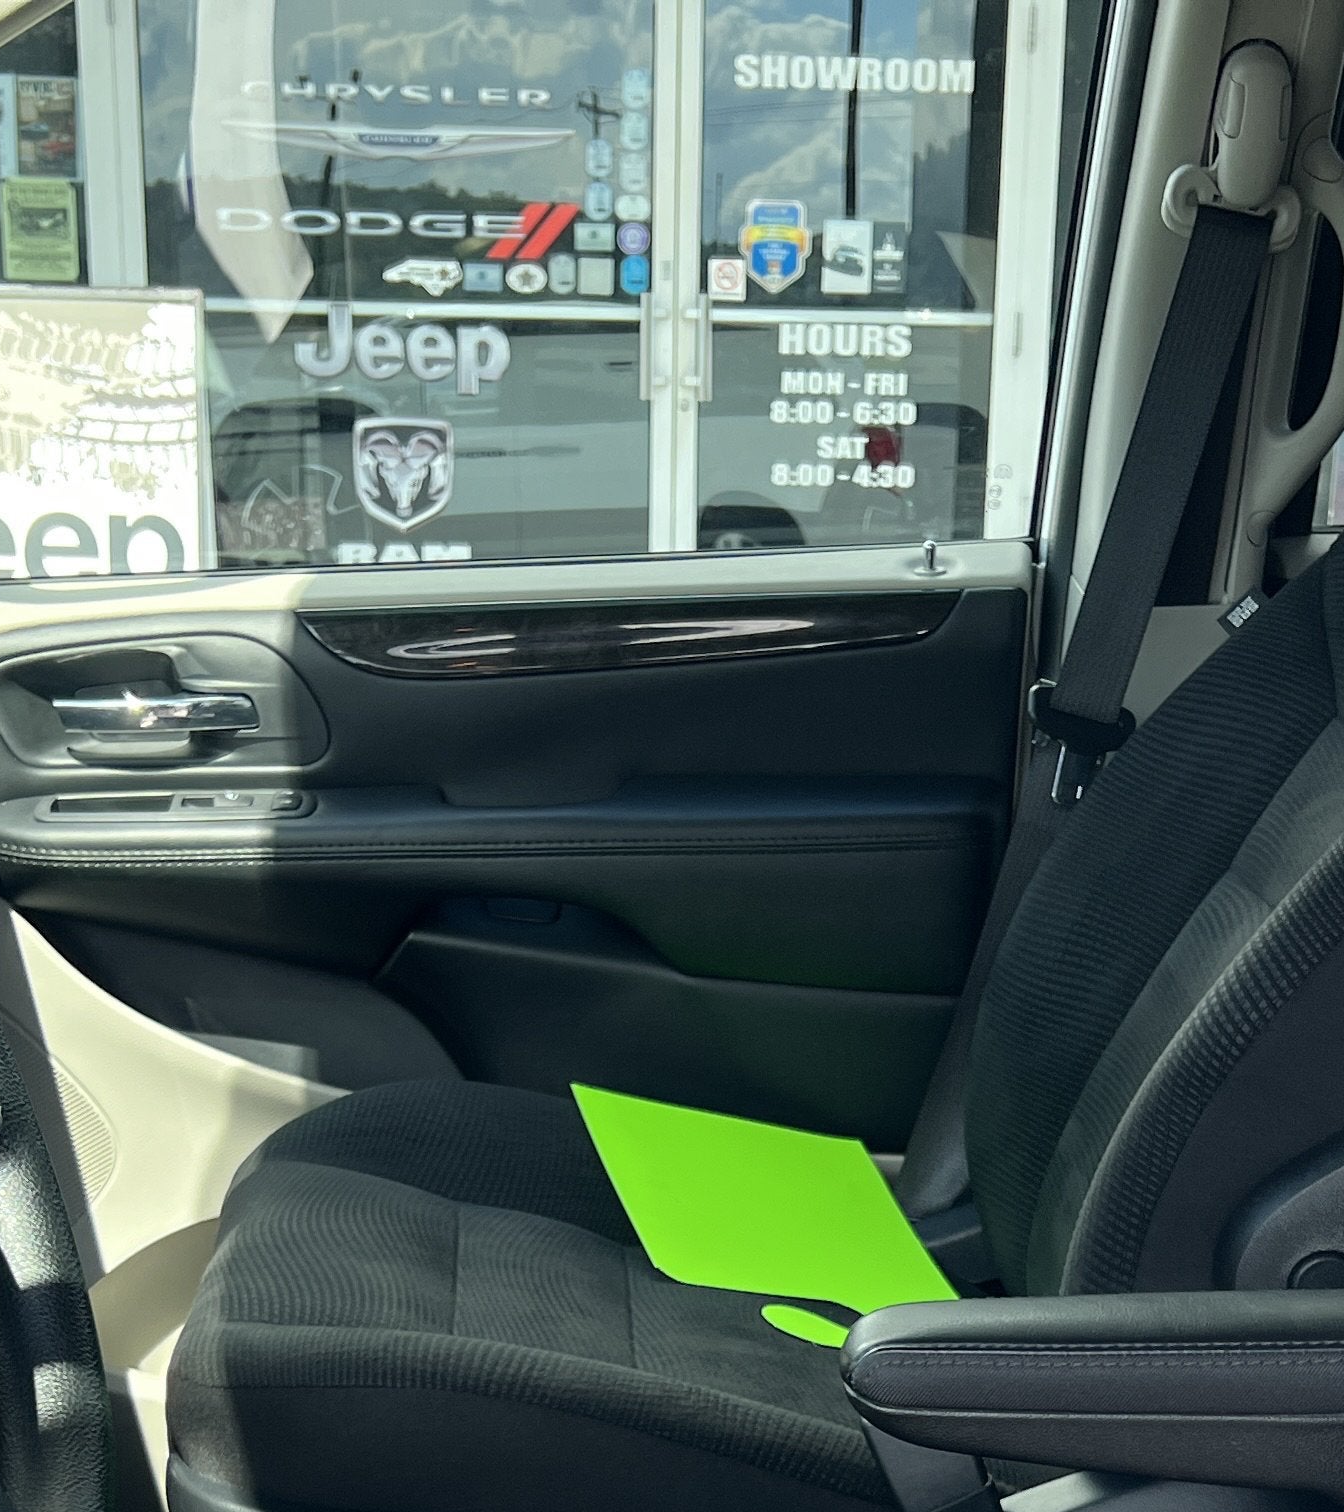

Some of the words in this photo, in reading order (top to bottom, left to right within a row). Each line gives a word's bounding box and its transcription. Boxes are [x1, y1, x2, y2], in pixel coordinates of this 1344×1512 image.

[734, 54, 976, 93] SHOWROOM
[241, 81, 552, 107] CHRYSLER
[215, 207, 528, 238] DODGE
[294, 303, 511, 396] Jeep
[778, 323, 913, 358] HOURS
[817, 435, 870, 460] SAT
